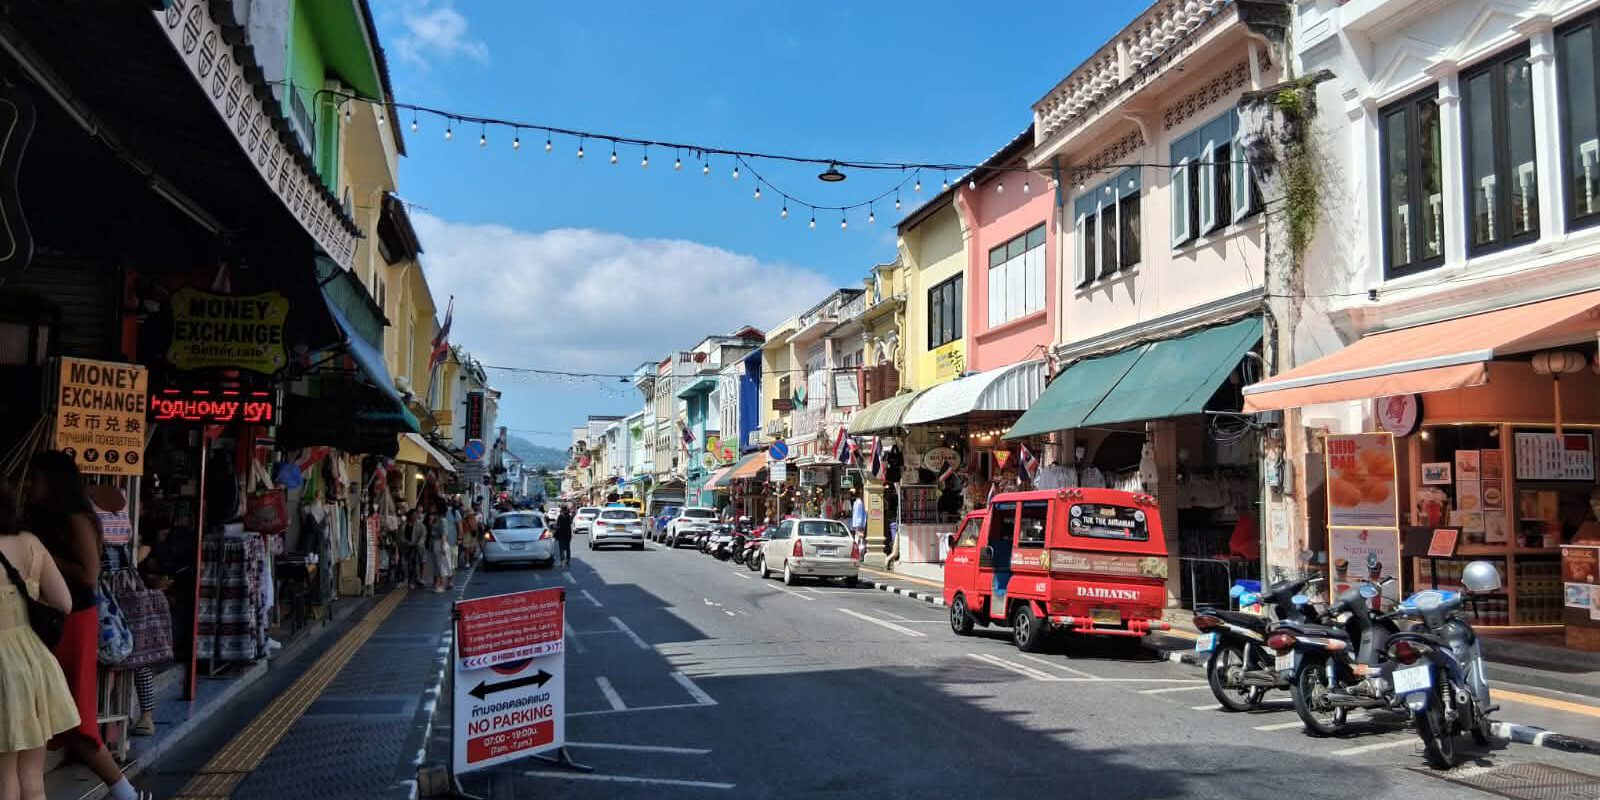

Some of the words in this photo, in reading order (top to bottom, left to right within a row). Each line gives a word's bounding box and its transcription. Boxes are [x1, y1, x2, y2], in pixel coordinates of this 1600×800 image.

[189, 297, 270, 320] MONEY
[175, 320, 281, 344] EXCHANGE
[70, 363, 140, 389] MONEY
[61, 386, 145, 413] EXCHANGE
[63, 412, 141, 433] 货币兑换
[1082, 516, 1094, 524] TUK
[1095, 517, 1106, 525] TUK
[1077, 586, 1141, 600] DAIHATSU
[468, 719, 490, 735] NO
[493, 704, 553, 729] PARKING
